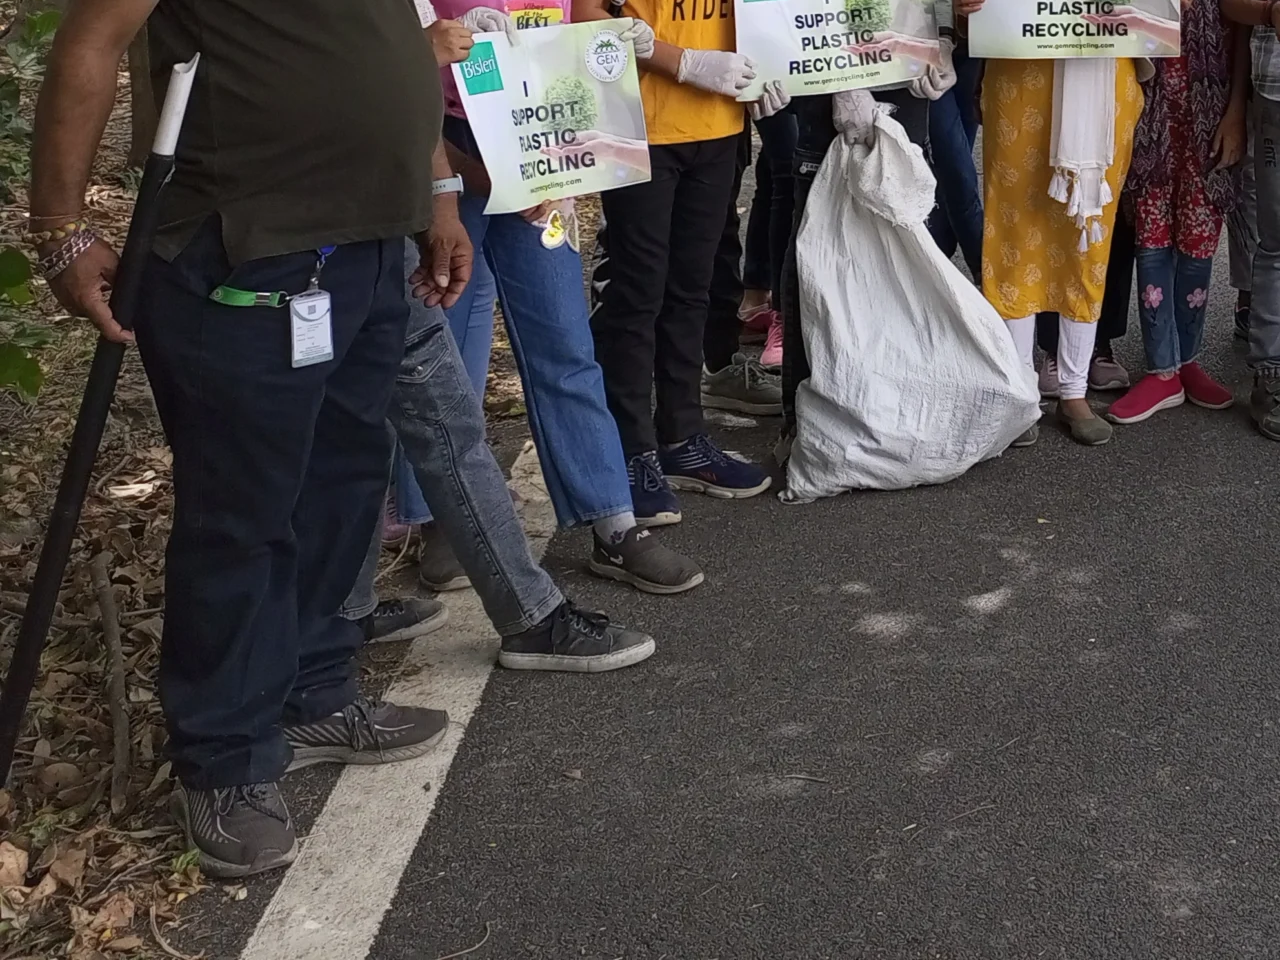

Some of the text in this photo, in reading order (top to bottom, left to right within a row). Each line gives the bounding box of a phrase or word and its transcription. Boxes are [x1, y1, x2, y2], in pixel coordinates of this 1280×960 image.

[794, 6, 874, 30] SUPPORT
[1037, 1, 1114, 16] PLASTIC
[516, 15, 551, 30] BEST
[1022, 22, 1128, 38] RECYCLING
[801, 29, 874, 52] PLASTIC
[1037, 42, 1115, 50] www.gemrecycling.com
[462, 55, 497, 79] Bisleri
[596, 53, 620, 65] GEM
[788, 48, 893, 76] RECYCLING
[523, 81, 529, 97] I
[511, 101, 579, 127] SUPPORT
[519, 128, 577, 153] PLASTIC
[519, 151, 596, 181] RECYCLING
[635, 529, 652, 541] AIR
